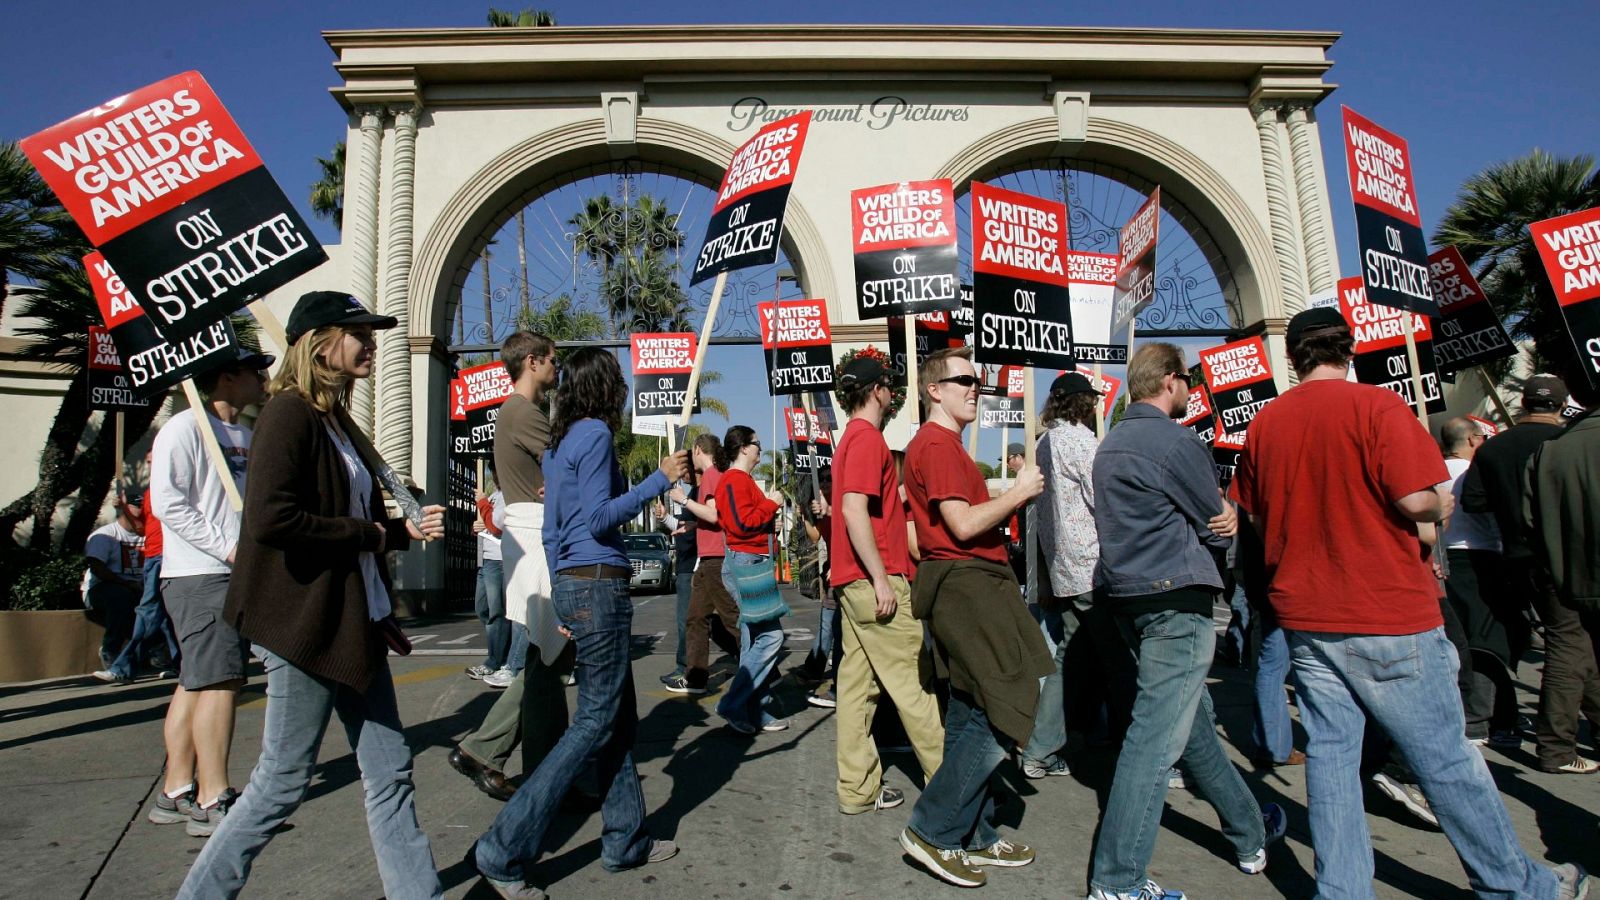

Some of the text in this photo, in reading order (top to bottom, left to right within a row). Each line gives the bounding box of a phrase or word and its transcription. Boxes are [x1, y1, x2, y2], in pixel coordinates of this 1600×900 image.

[867, 96, 970, 131] Pictures
[42, 89, 201, 173] WRITERS
[74, 120, 214, 195] GUILD OF
[731, 122, 799, 169] WRITERS
[1347, 122, 1405, 170] WRITERS
[727, 145, 792, 185] GUILD OF
[1354, 148, 1408, 191] GUILD OF
[89, 137, 245, 228] AMERICA
[717, 159, 791, 206] AMERICA
[1356, 171, 1416, 216] AMERICA
[857, 188, 944, 213] WRITERS
[728, 202, 751, 229] ON
[863, 207, 943, 228] GUILD OF
[978, 196, 1059, 234] WRITERS
[1121, 199, 1156, 243] WRITERS
[175, 208, 223, 250] ON
[859, 221, 950, 245] AMERICA
[984, 219, 1058, 254] GUILD OF
[1122, 223, 1148, 257] GUILD
[1385, 225, 1404, 254] ON
[696, 218, 777, 274] STRIKE
[980, 241, 1064, 276] AMERICA
[1119, 230, 1155, 274] AMERICA
[146, 212, 309, 325] STRIKE
[893, 255, 917, 275] ON
[1103, 266, 1116, 275] OF
[1128, 266, 1140, 288] ON
[1365, 248, 1434, 303] STRIKE
[862, 273, 955, 308] STRIKE
[1444, 274, 1461, 290] OF
[1014, 289, 1036, 314] ON
[1115, 271, 1153, 325] STRIKE
[808, 319, 821, 328] OF
[981, 312, 1070, 356] STRIKE
[1440, 319, 1463, 338] ON
[636, 338, 690, 350] WRITERS
[639, 348, 690, 359] GUILD OF
[1073, 346, 1127, 361] TRIKE
[1203, 343, 1258, 367] WRITERS
[637, 357, 696, 370] AMERICA
[791, 352, 807, 365] ON
[1210, 356, 1260, 377] GUILD OF
[1386, 355, 1408, 377] ON
[468, 377, 512, 394] GUILD OF
[658, 378, 674, 390] ON
[1211, 364, 1268, 388] AMERICA
[467, 384, 515, 405] AMERICA
[1000, 399, 1011, 410] ON
[1237, 389, 1253, 404] ON
